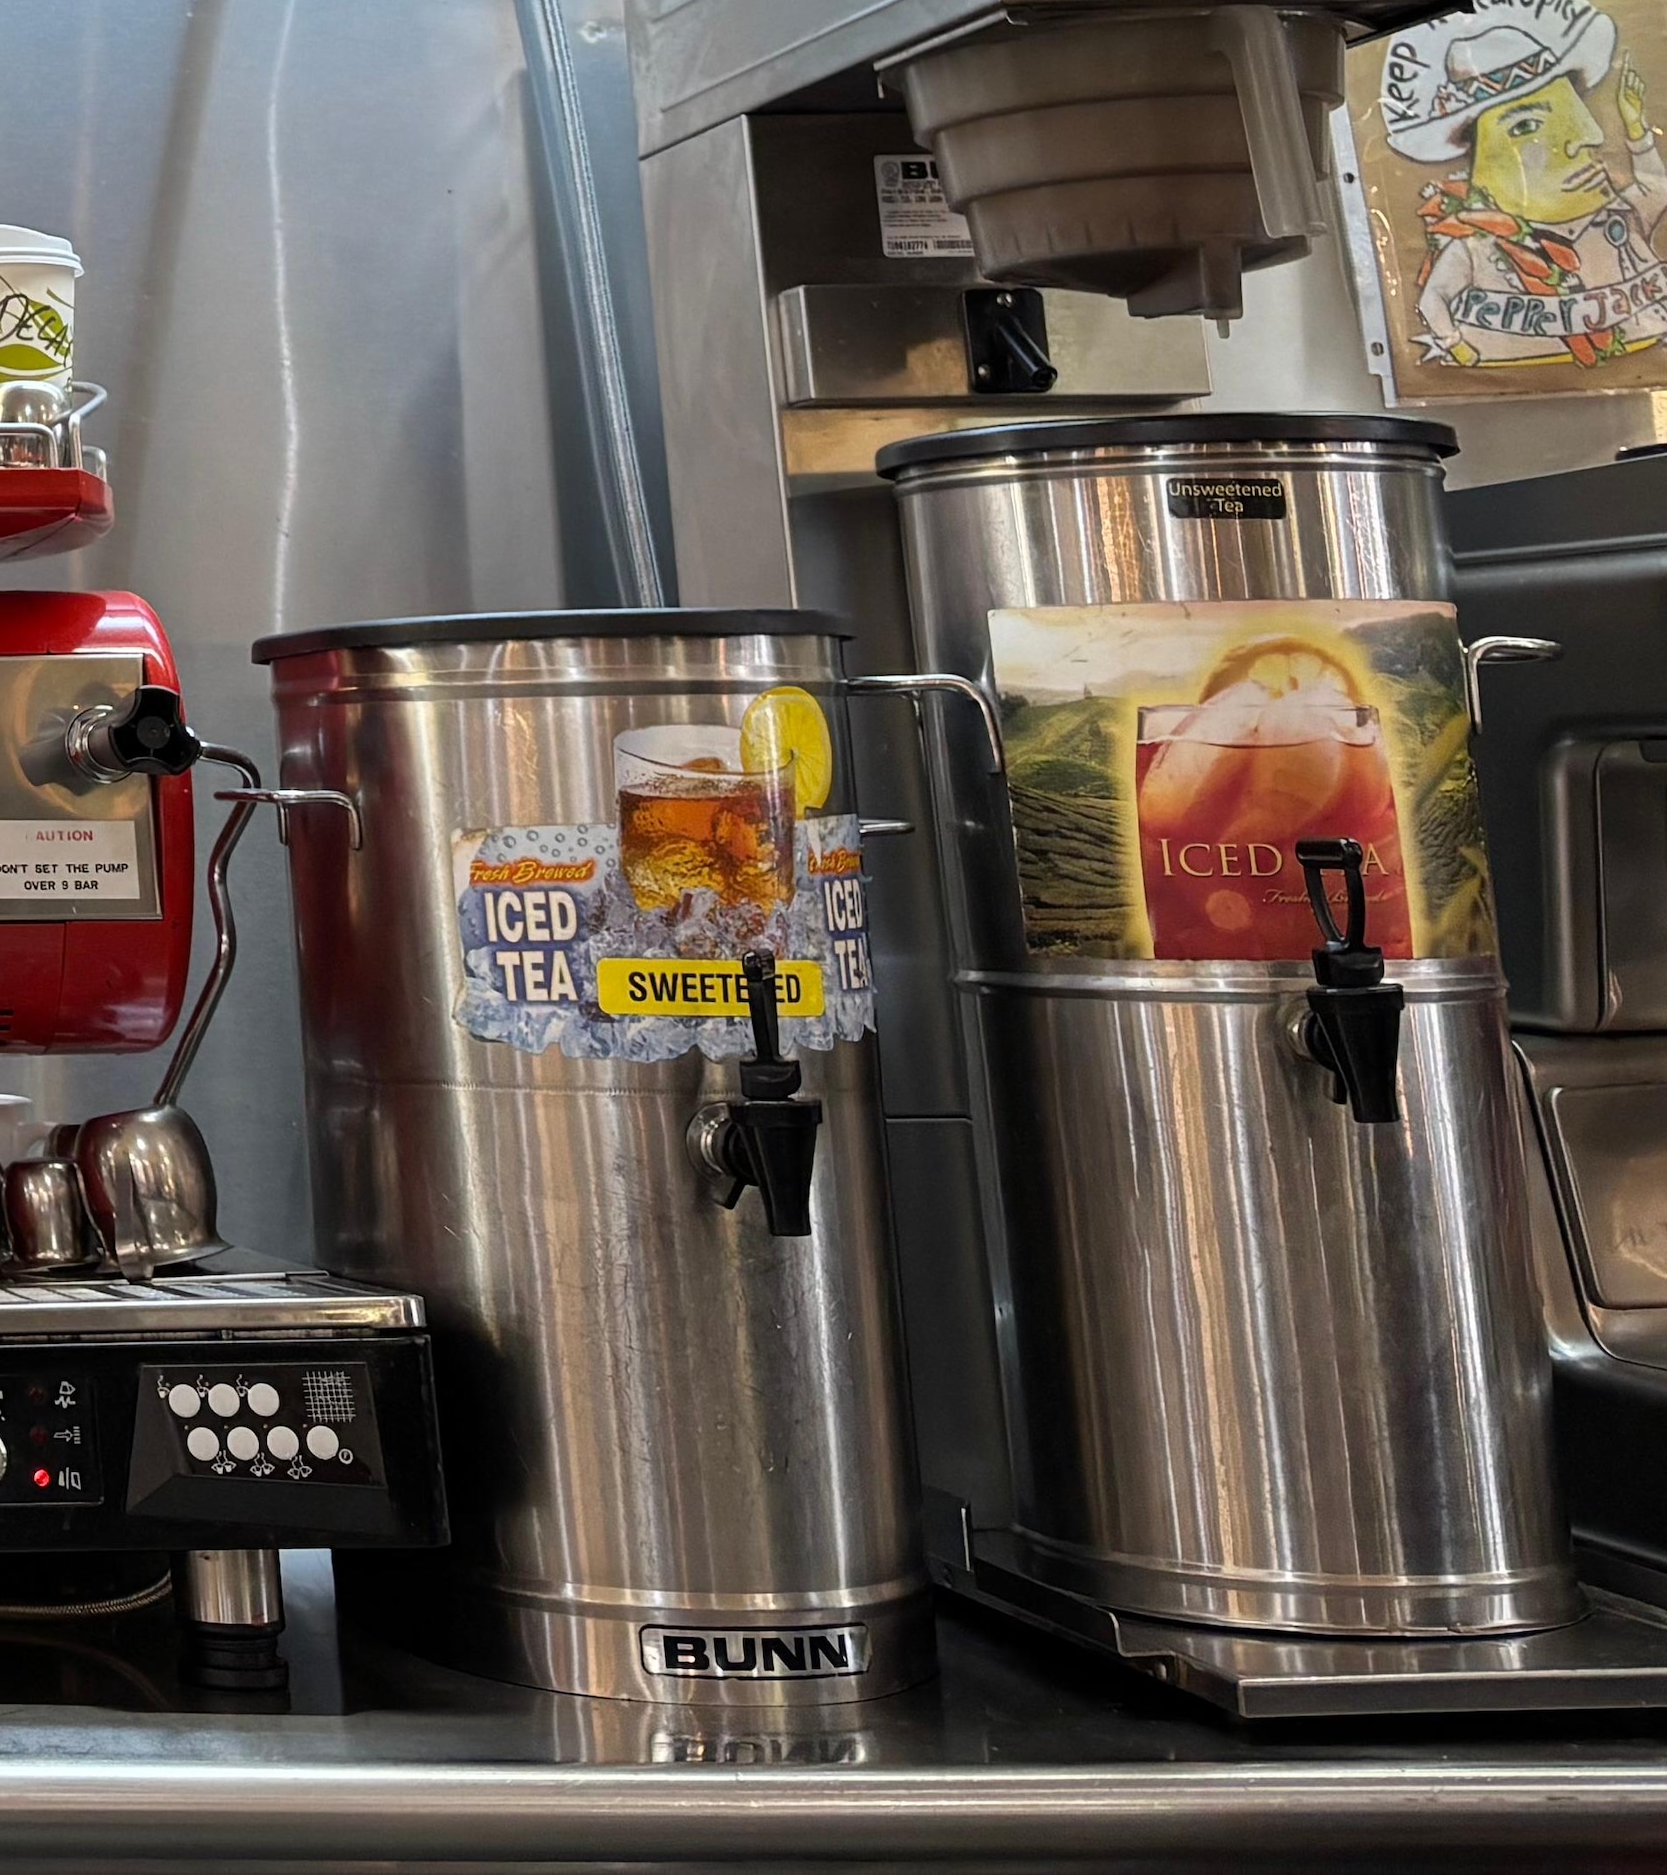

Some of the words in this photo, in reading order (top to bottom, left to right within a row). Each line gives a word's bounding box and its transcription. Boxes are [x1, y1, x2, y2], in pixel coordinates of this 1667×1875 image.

[1167, 482, 1283, 497] Unsweetened
[1213, 497, 1244, 513] Tea
[35, 864, 59, 875] SET
[66, 863, 90, 874] THE
[95, 863, 129, 874] PUMP
[1158, 837, 1284, 877] ICED
[23, 880, 56, 891] OVER
[74, 880, 99, 891] BAR
[483, 890, 578, 944] ICED
[823, 878, 864, 932] ICED
[495, 950, 580, 1002] TEA
[628, 971, 803, 1005] SWEETEED
[662, 1634, 850, 1672] BUNN
